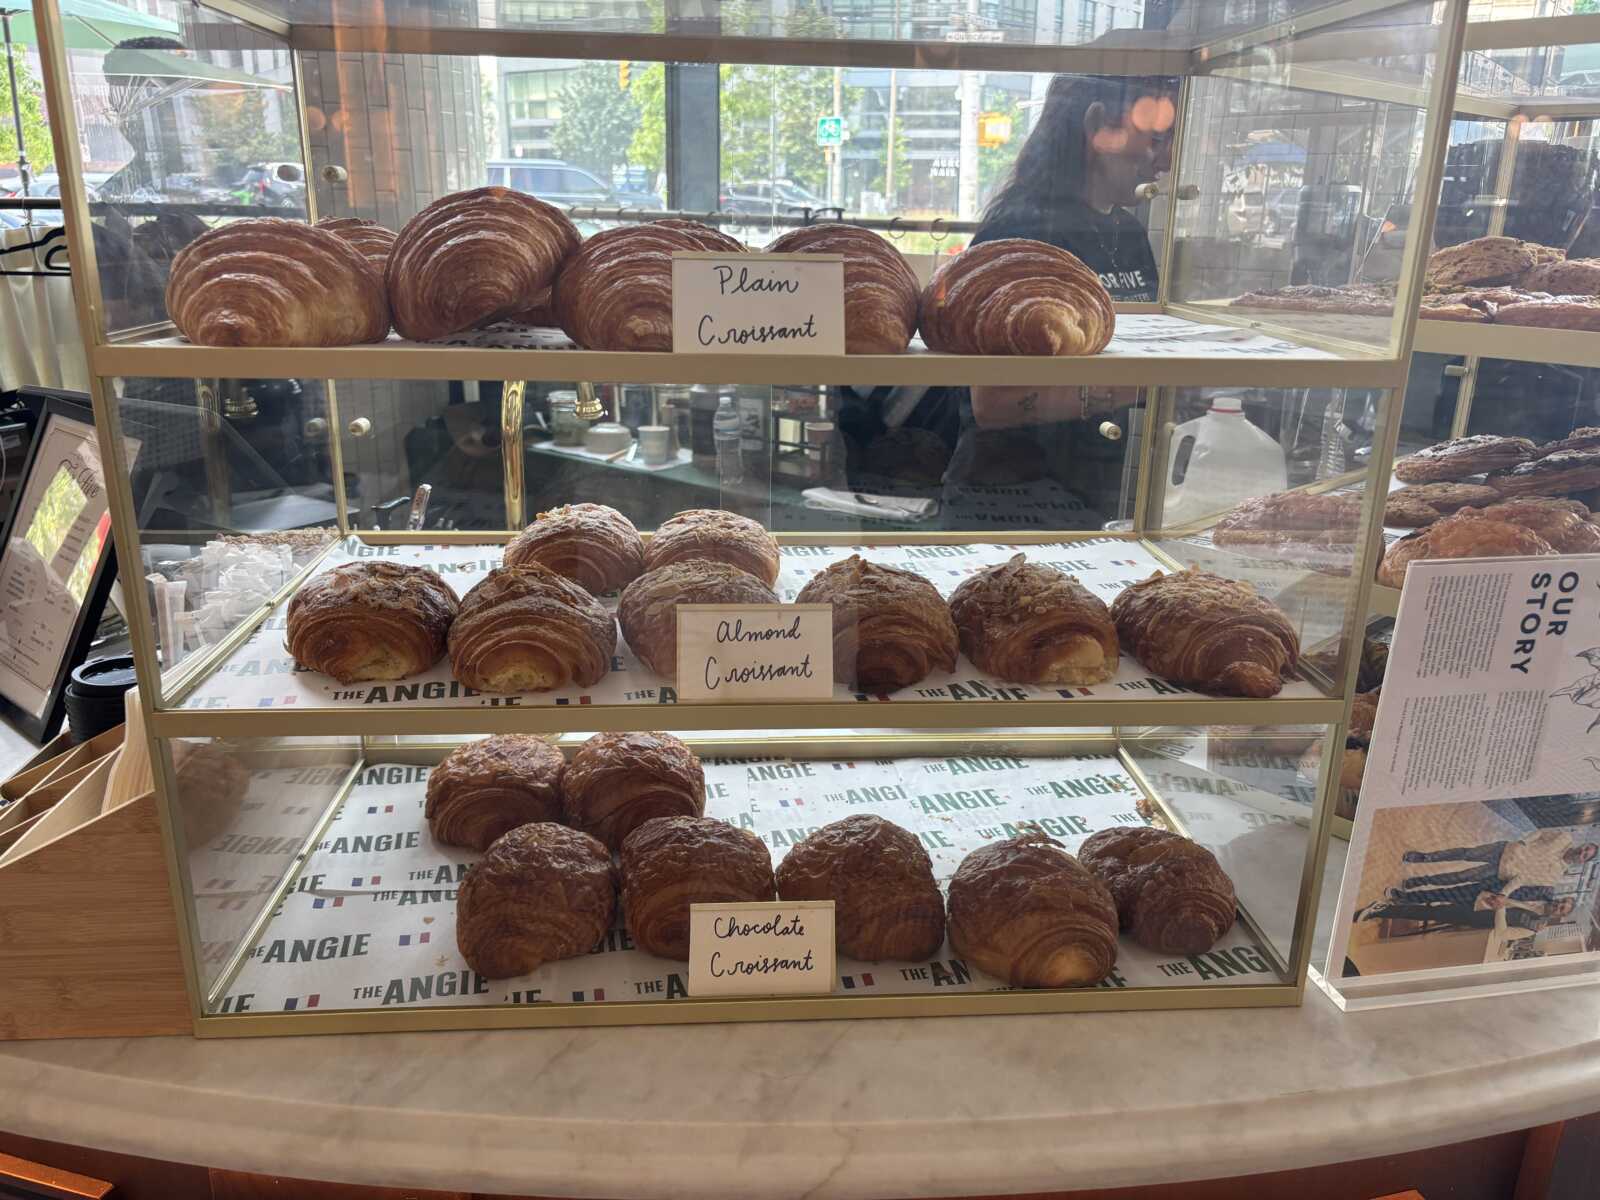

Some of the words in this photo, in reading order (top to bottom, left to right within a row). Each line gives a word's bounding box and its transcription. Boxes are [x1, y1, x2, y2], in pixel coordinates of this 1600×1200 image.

[713, 265, 799, 295] Plain
[1098, 272, 1120, 289] OR
[698, 315, 817, 346] Croissant
[339, 539, 401, 557] NGIE
[781, 545, 834, 557] NGIE
[1545, 571, 1580, 636] OUR
[716, 615, 801, 643] Almond
[1510, 572, 1552, 674] STORY
[705, 653, 813, 690] Croissant
[333, 690, 365, 701] THE
[623, 689, 657, 701] THE
[915, 688, 949, 698] THE
[1115, 681, 1151, 692] THE
[747, 763, 816, 781] ANGIE
[922, 763, 948, 774] THE
[944, 756, 1029, 775] ANGIE
[352, 767, 428, 785] ANGIE
[1024, 784, 1051, 796] THE
[1048, 773, 1135, 799] ANGIE
[824, 793, 846, 803] THE
[845, 784, 908, 804] ANGI
[918, 788, 1007, 815] ANGIE
[329, 831, 420, 854] ANGIE
[408, 869, 435, 881] THE
[372, 890, 400, 902] THE
[714, 915, 804, 938] Chocolate
[262, 933, 372, 963] ANGIE
[711, 950, 813, 977] Croissant
[1156, 962, 1193, 977] THE
[1184, 946, 1273, 981] ANG
[899, 967, 929, 981] THE
[353, 985, 384, 1000] THE
[381, 970, 489, 1006] ANGIE
[634, 980, 664, 995] THE
